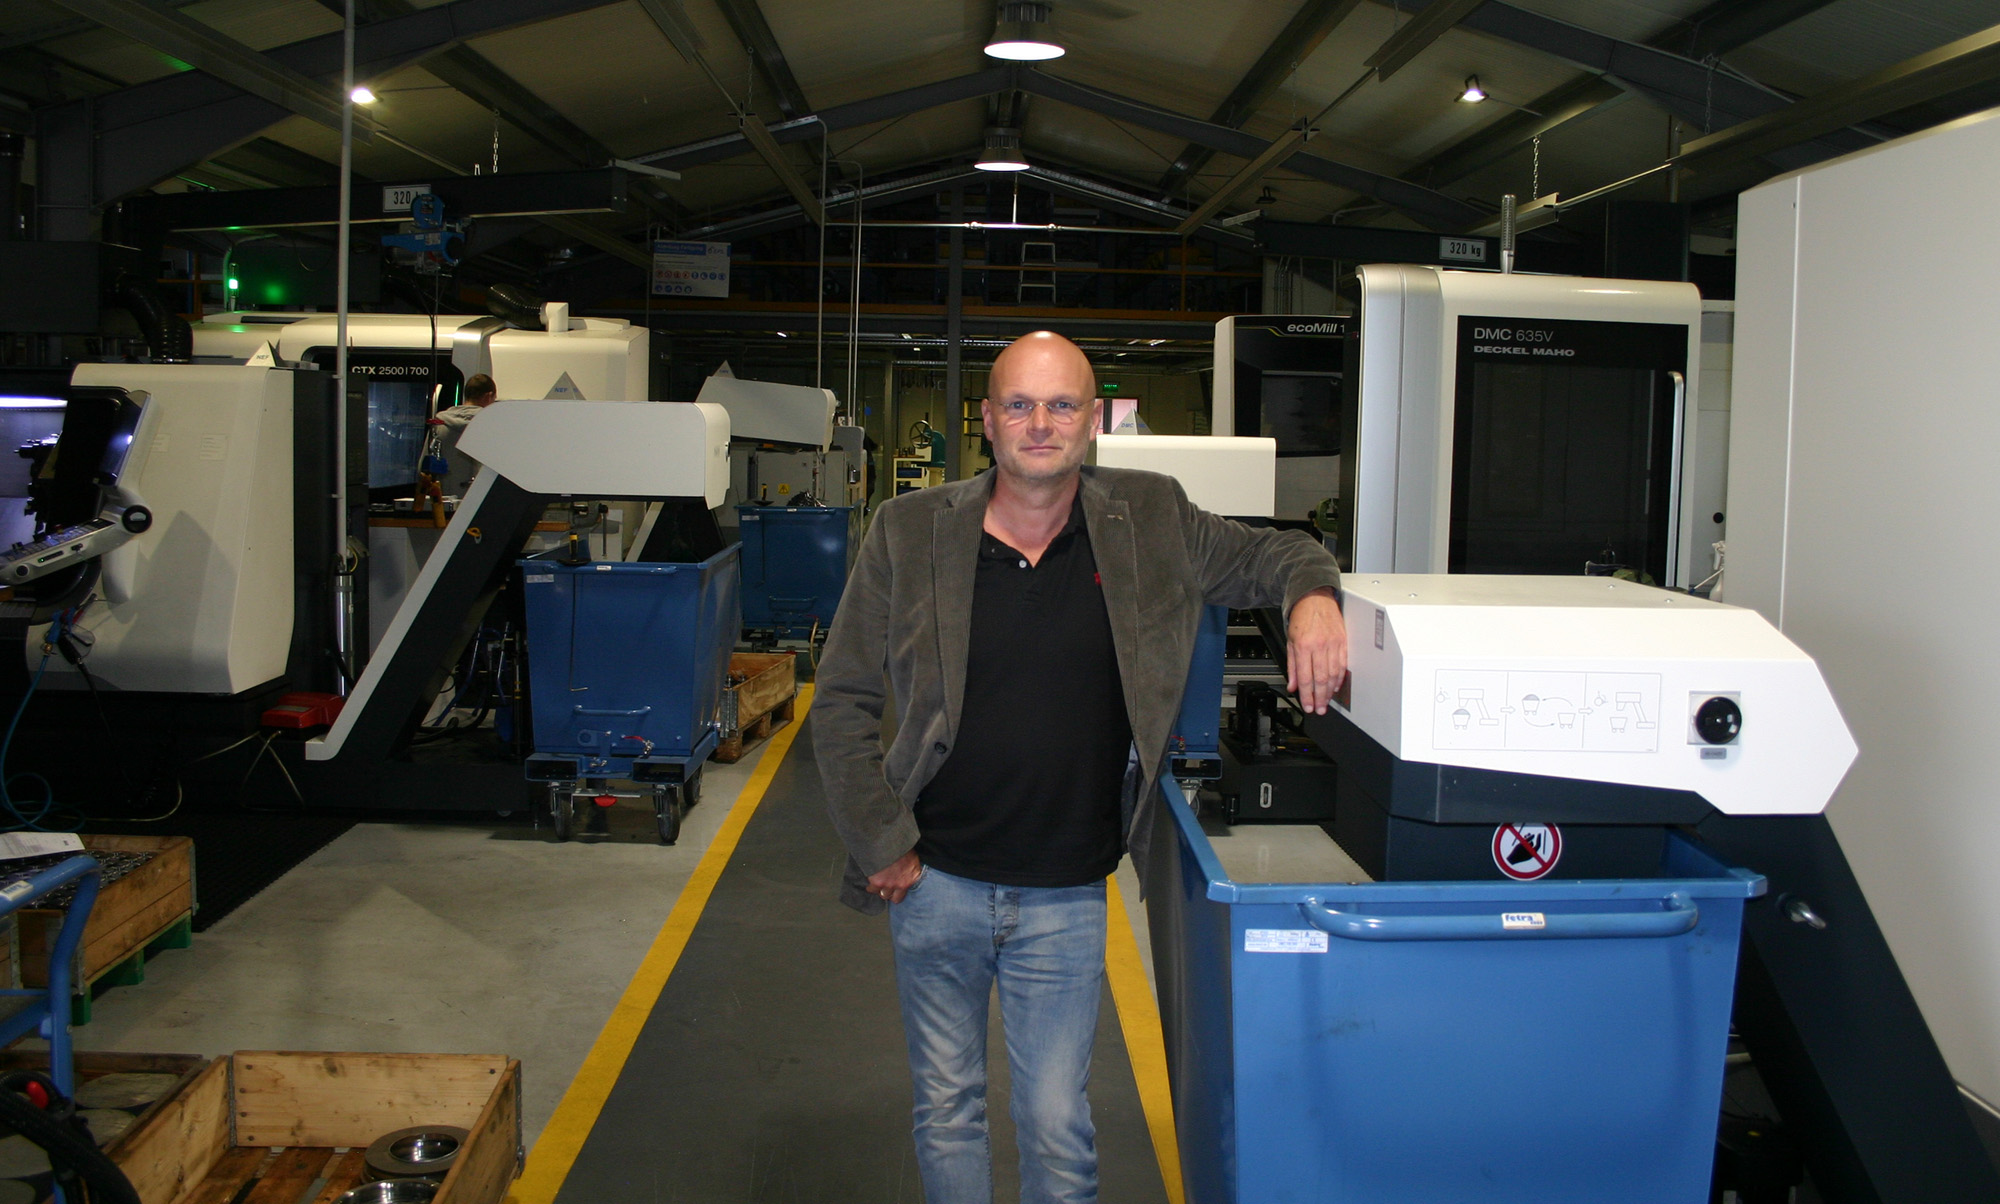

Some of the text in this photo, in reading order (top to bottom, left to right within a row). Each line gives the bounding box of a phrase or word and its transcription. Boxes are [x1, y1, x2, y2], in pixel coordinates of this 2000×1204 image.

[393, 191, 411, 205] 320
[1450, 242, 1481, 257] 320 kg
[1287, 323, 1338, 333] ecoMill
[1474, 327, 1554, 342] DMC 635V
[1473, 345, 1575, 357] DECKEL MAHO
